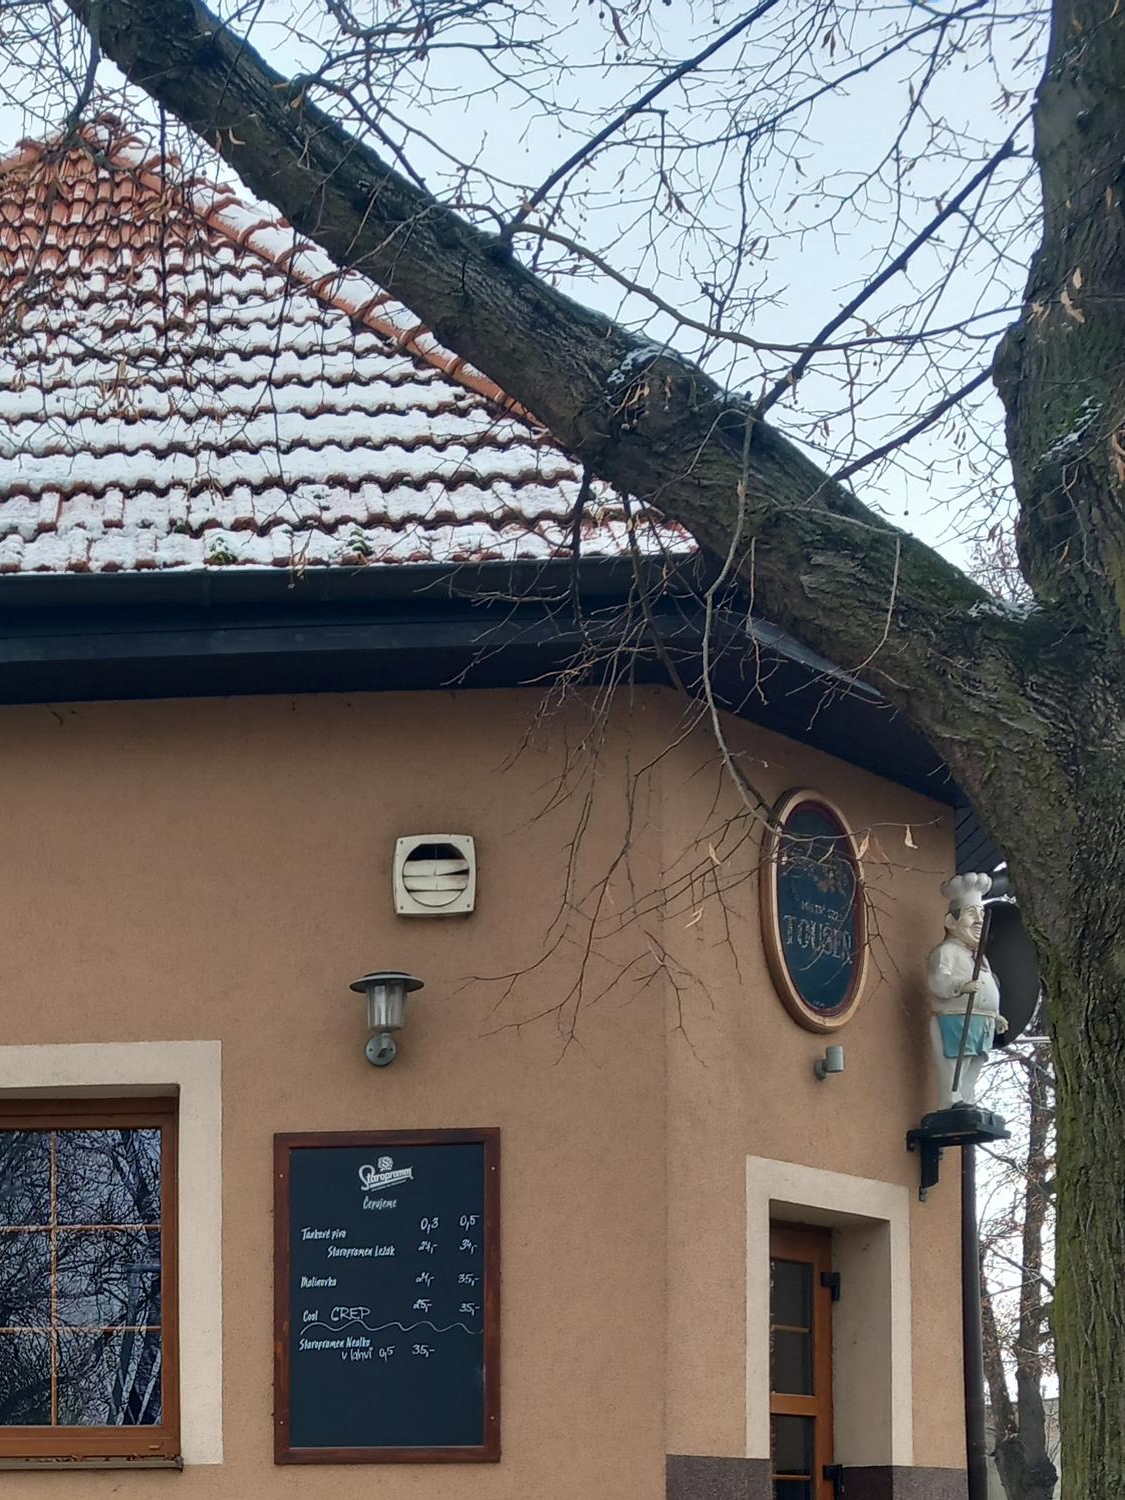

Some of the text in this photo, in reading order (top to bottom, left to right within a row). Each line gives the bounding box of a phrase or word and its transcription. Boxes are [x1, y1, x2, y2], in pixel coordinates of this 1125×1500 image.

[420, 1215, 480, 1235] 0,3 0,5
[331, 1229, 347, 1240] pivo
[458, 1273, 479, 1287] 35,-
[459, 1302, 480, 1316] 35,-
[379, 1345, 395, 1363] 0,5
[412, 1344, 435, 1358] 35,-
